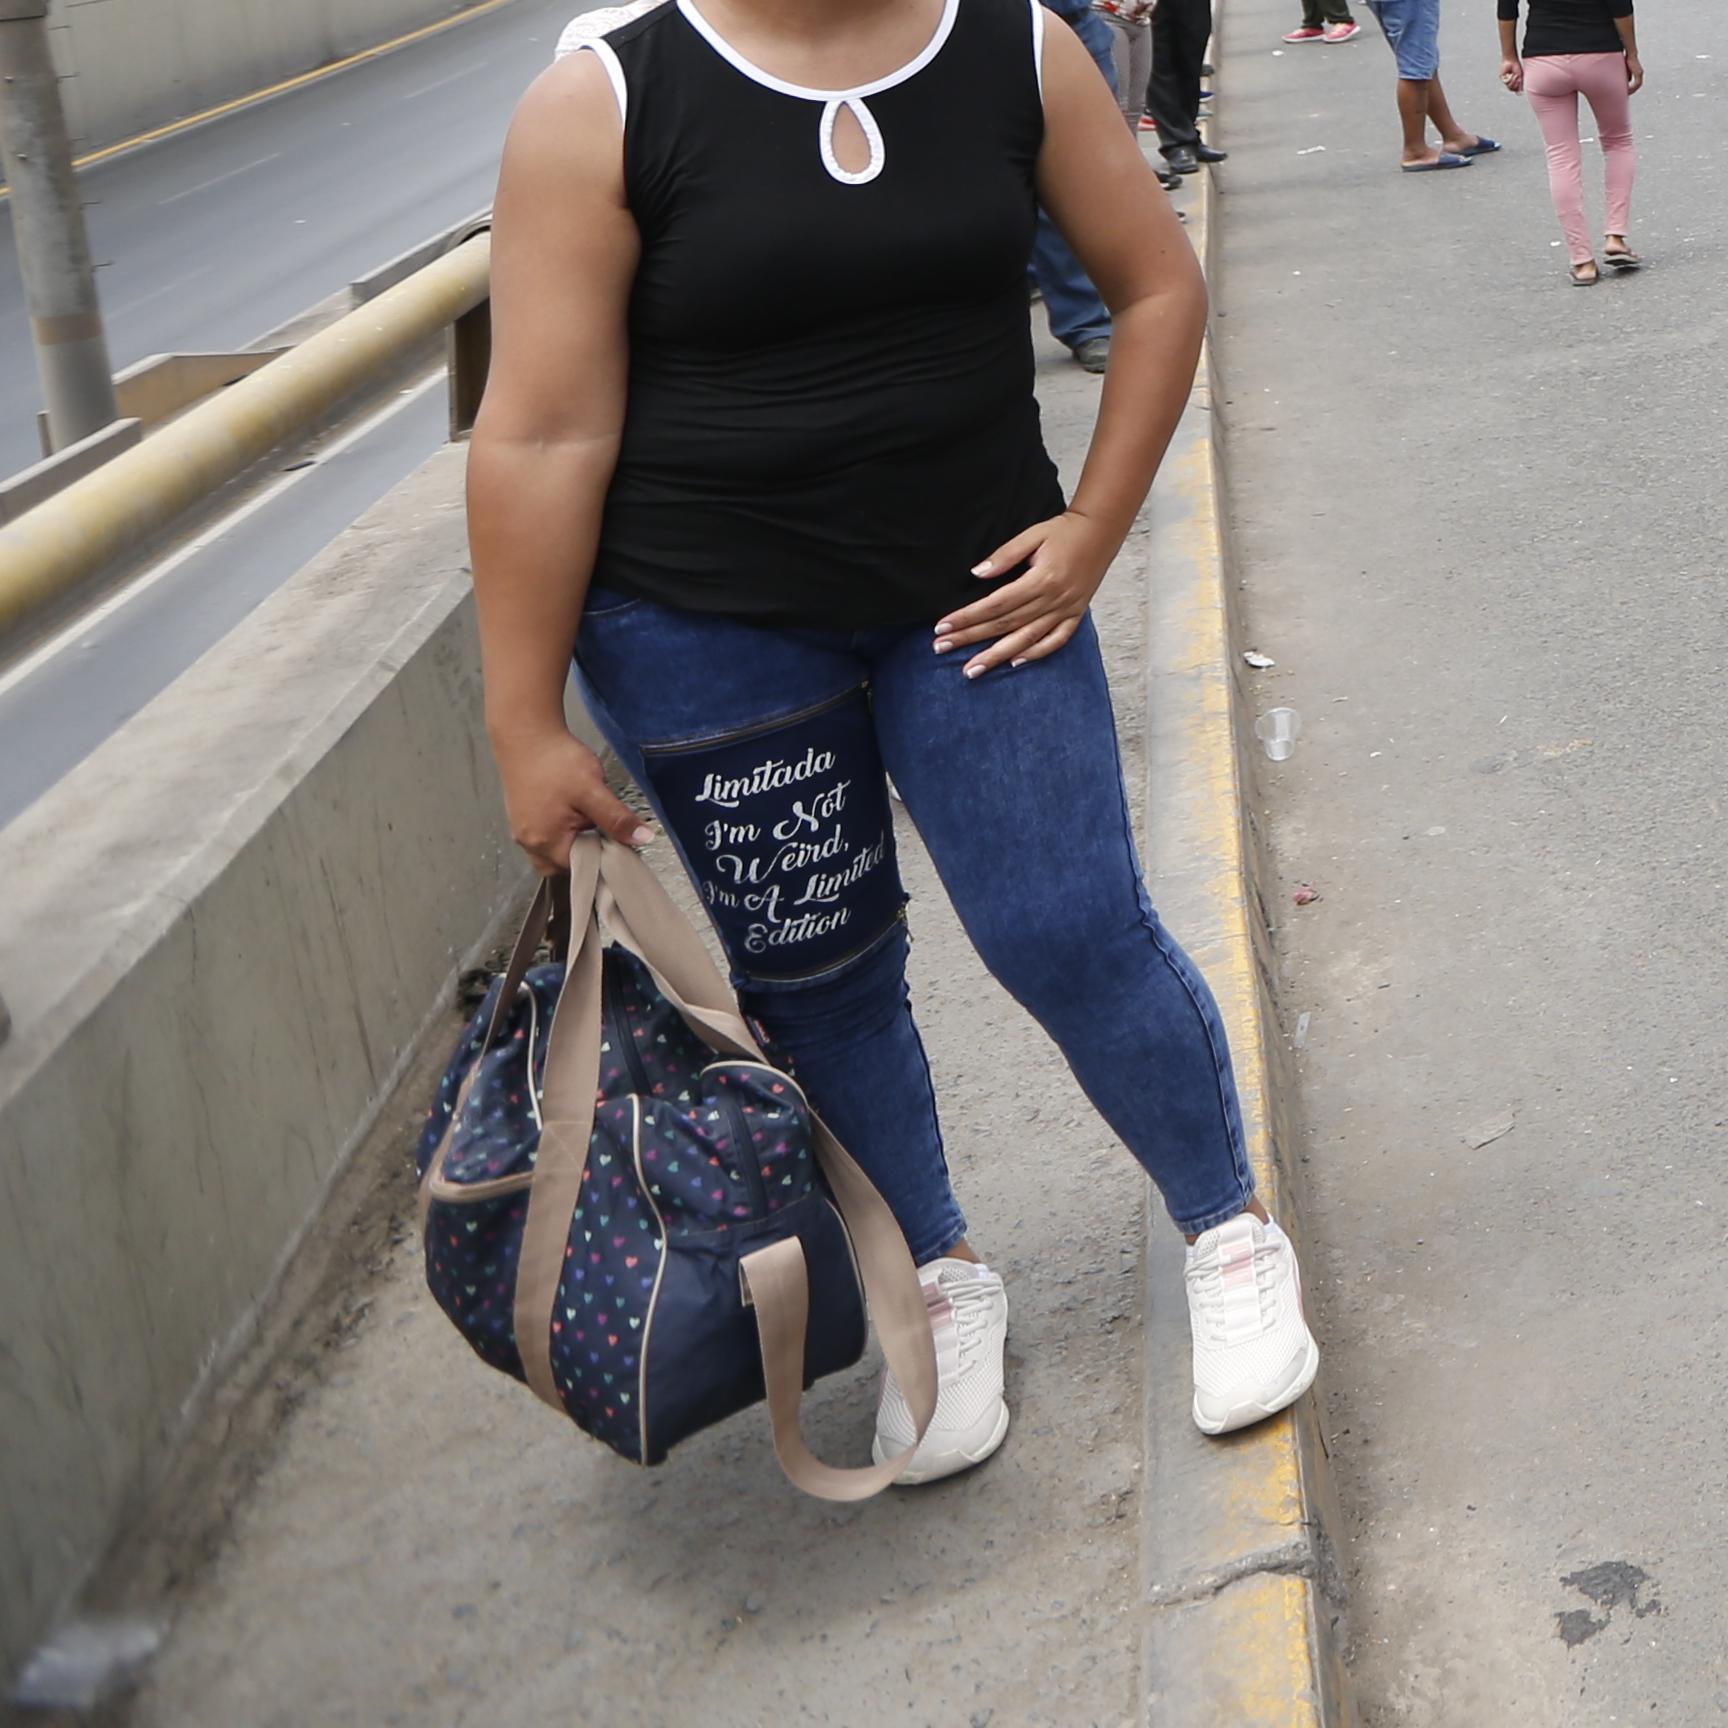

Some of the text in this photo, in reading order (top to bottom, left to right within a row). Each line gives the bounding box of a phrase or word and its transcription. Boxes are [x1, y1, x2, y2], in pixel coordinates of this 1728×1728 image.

[695, 748, 836, 808] Limitada
[705, 780, 851, 851] I'm Not
[703, 829, 885, 923] I'm A Limited
[716, 824, 849, 884] Weird,
[744, 907, 852, 953] Edition
